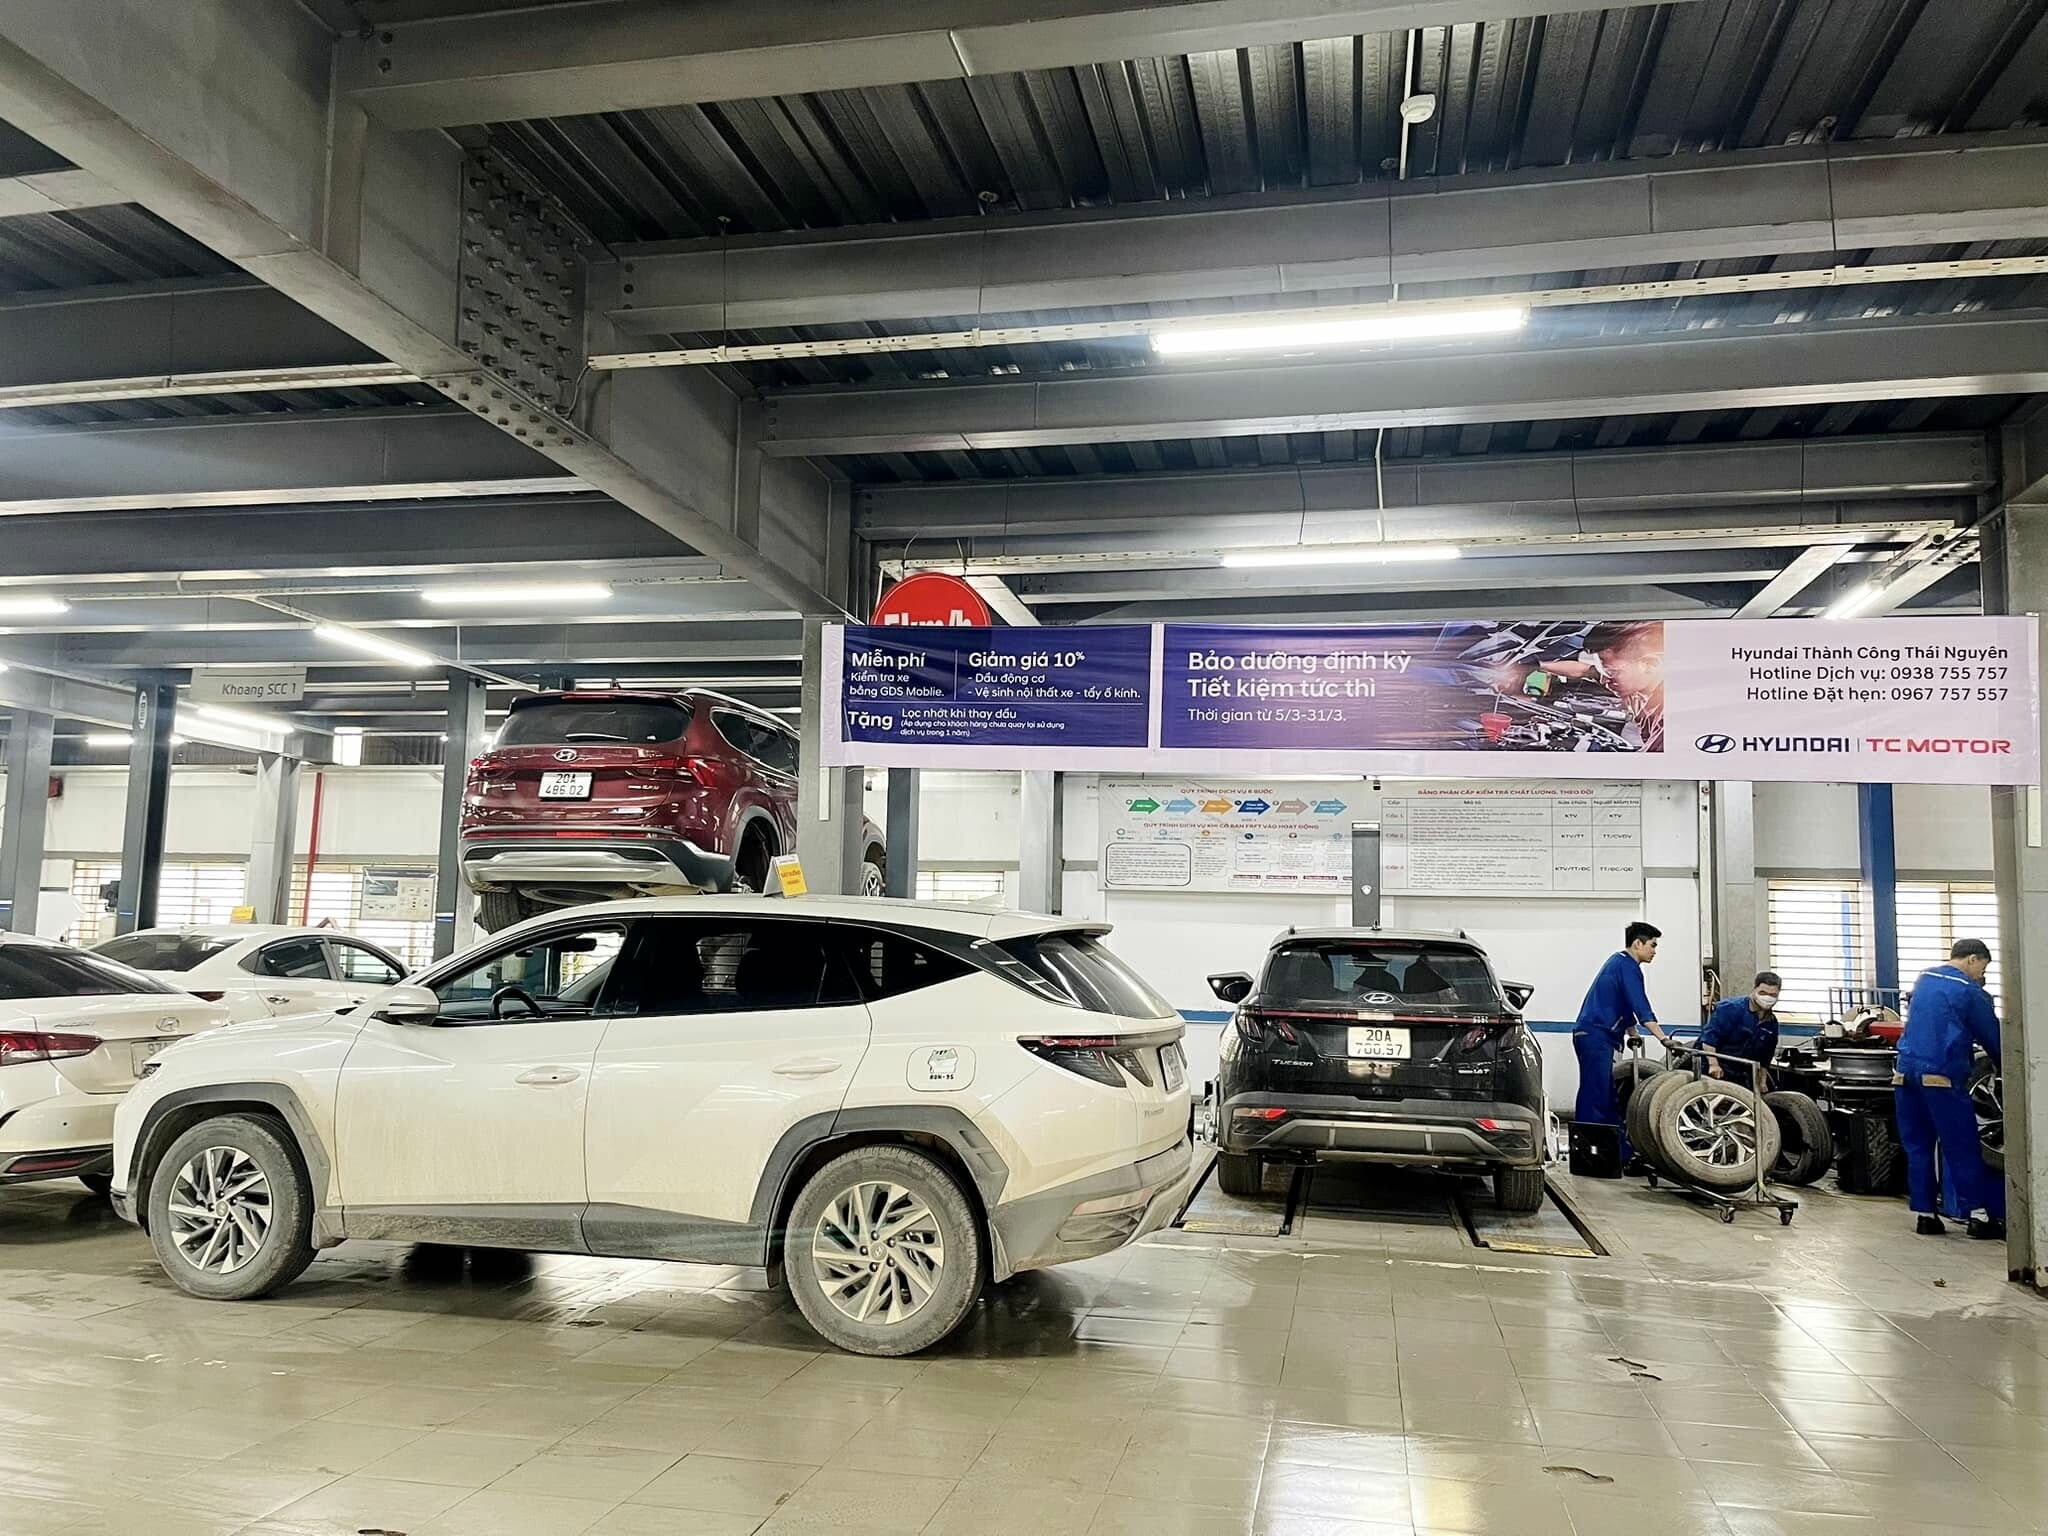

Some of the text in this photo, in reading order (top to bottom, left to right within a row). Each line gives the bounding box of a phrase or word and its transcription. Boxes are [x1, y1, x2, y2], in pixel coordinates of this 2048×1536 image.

[851, 649, 926, 670] Miễn phí
[968, 651, 1086, 670] Giảm giá 10%
[1188, 649, 1411, 674] Bảo dưỡng định kỳ
[1731, 645, 2008, 662] Hyundai Thành Công Thái Nguyên
[879, 673, 895, 682] tra
[897, 674, 910, 682] xe
[1000, 673, 1029, 685] động
[1031, 674, 1045, 683] cơ
[1750, 666, 2008, 682] Hotline Dịch vụ: 0938 755 757
[222, 682, 296, 698] Khoang SCC 1
[880, 686, 904, 697] GDS
[974, 687, 990, 699] Vệ
[992, 687, 1014, 698] sinh
[1016, 687, 1033, 698] nội
[1036, 687, 1058, 698] thất
[1060, 690, 1074, 698] xe
[1104, 686, 1112, 698] ố
[1114, 687, 1141, 699] kính.
[1187, 675, 1376, 701] Tiết kiệm tức thì
[1747, 686, 2008, 703] Hotline Đặt hẹn: 0967 757 557
[847, 711, 893, 731] Tặng
[901, 708, 921, 719] Lọc
[923, 708, 948, 718] nhớt
[950, 708, 966, 718] khi
[968, 709, 993, 720] thay
[1188, 708, 1346, 724] Thời gian từ 5/3-31/3.
[900, 728, 915, 736] dịch
[916, 729, 926, 737] vụ
[926, 729, 945, 737] trong
[913, 720, 932, 728] dụng
[947, 720, 969, 728] khách
[970, 720, 988, 729] hàng
[1008, 721, 1026, 729] quay
[1026, 721, 1036, 729] lại
[1046, 721, 1065, 730] dụng
[1742, 737, 2011, 754] HYUNDAI TC MOTOR
[555, 773, 576, 784] 20A
[1365, 1029, 1392, 1042] 20A
